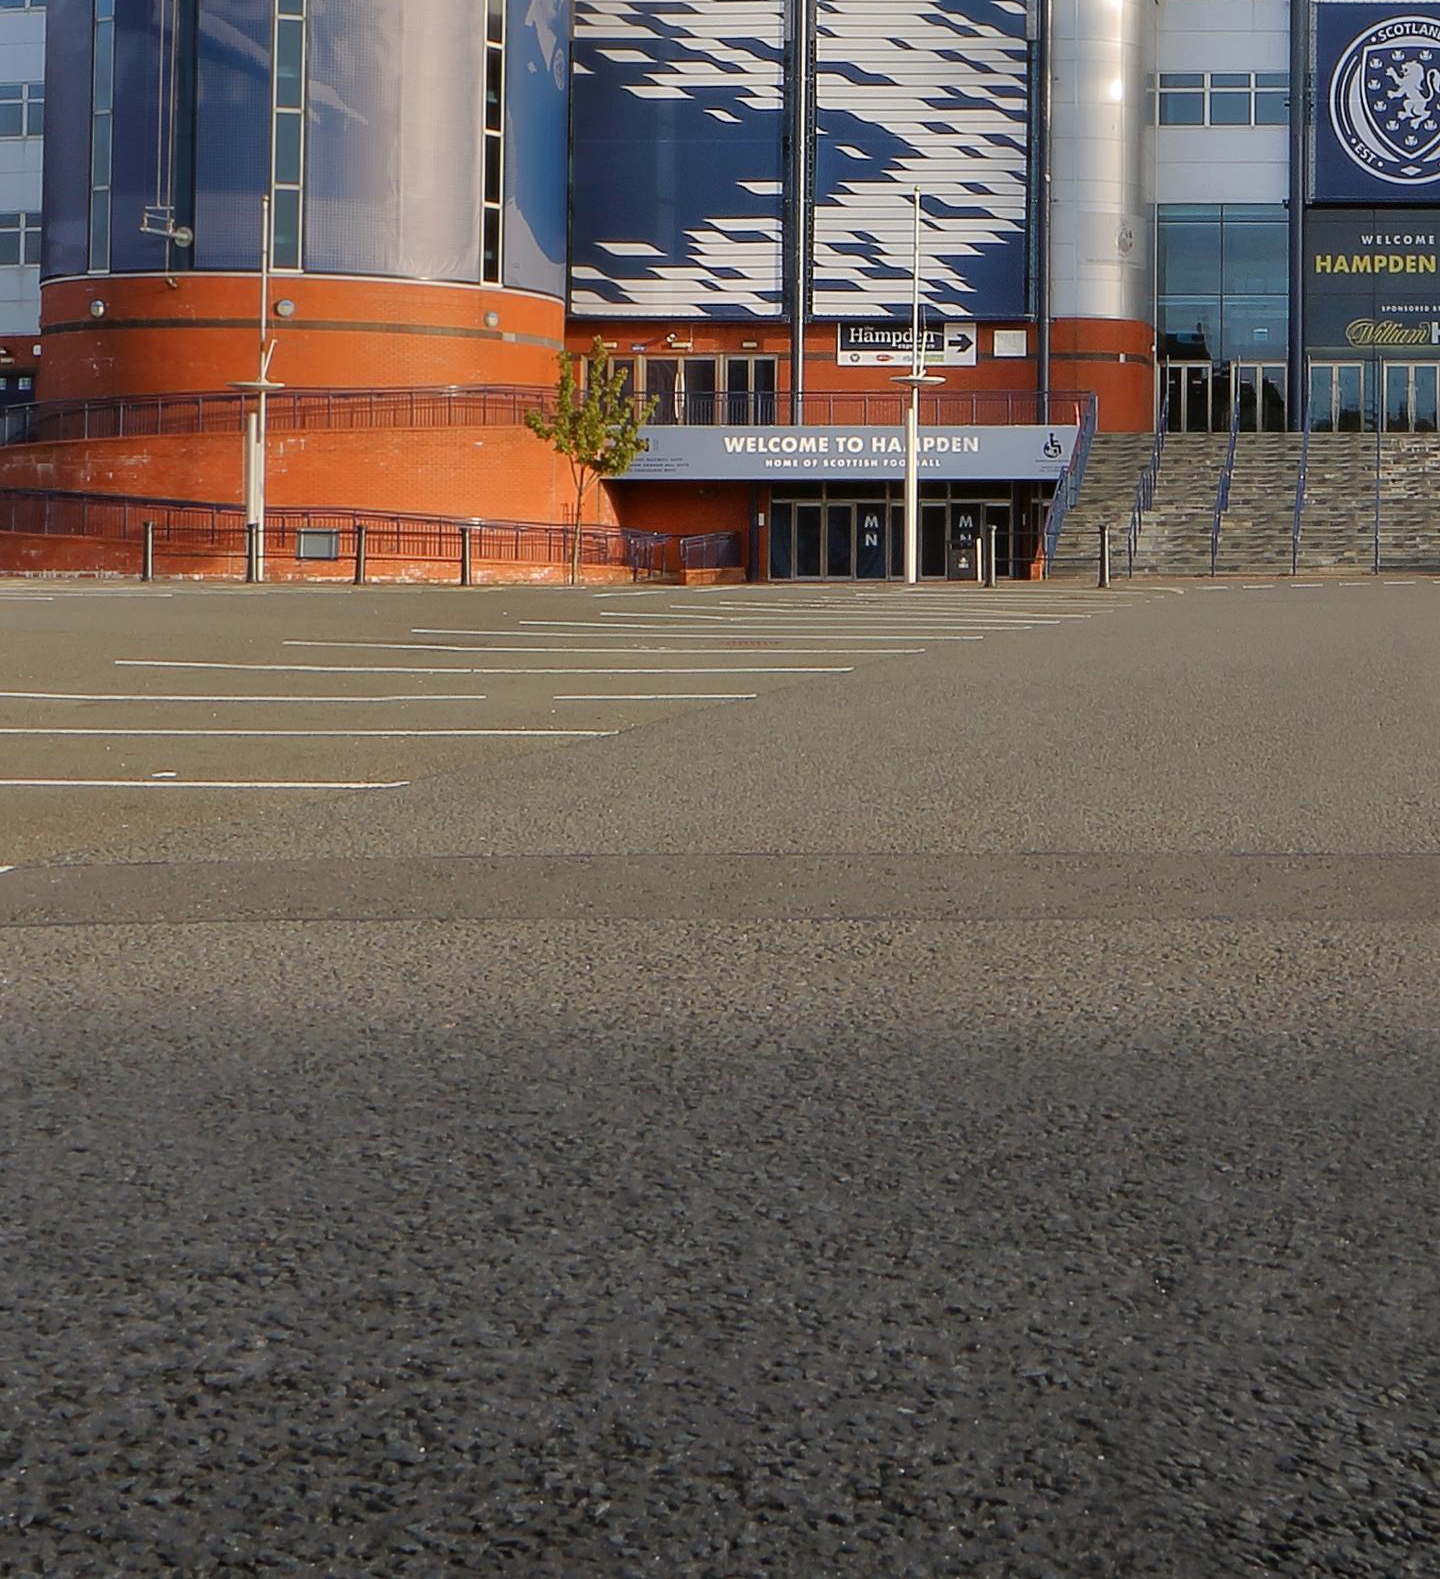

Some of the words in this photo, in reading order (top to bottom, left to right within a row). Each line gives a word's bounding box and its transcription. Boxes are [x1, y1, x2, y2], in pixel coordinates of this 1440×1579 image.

[1353, 143, 1377, 165] EST
[1361, 235, 1435, 245] WELCOME
[1315, 255, 1436, 273] HAMPDEN
[1381, 305, 1429, 313] SPONSORED
[1346, 318, 1430, 346] William
[724, 437, 828, 452] WELCOME
[836, 437, 863, 452] TO
[765, 459, 798, 467] HOME
[803, 459, 818, 467] OF
[823, 459, 878, 467] SCOTTISH
[883, 459, 941, 467] FOOALL
